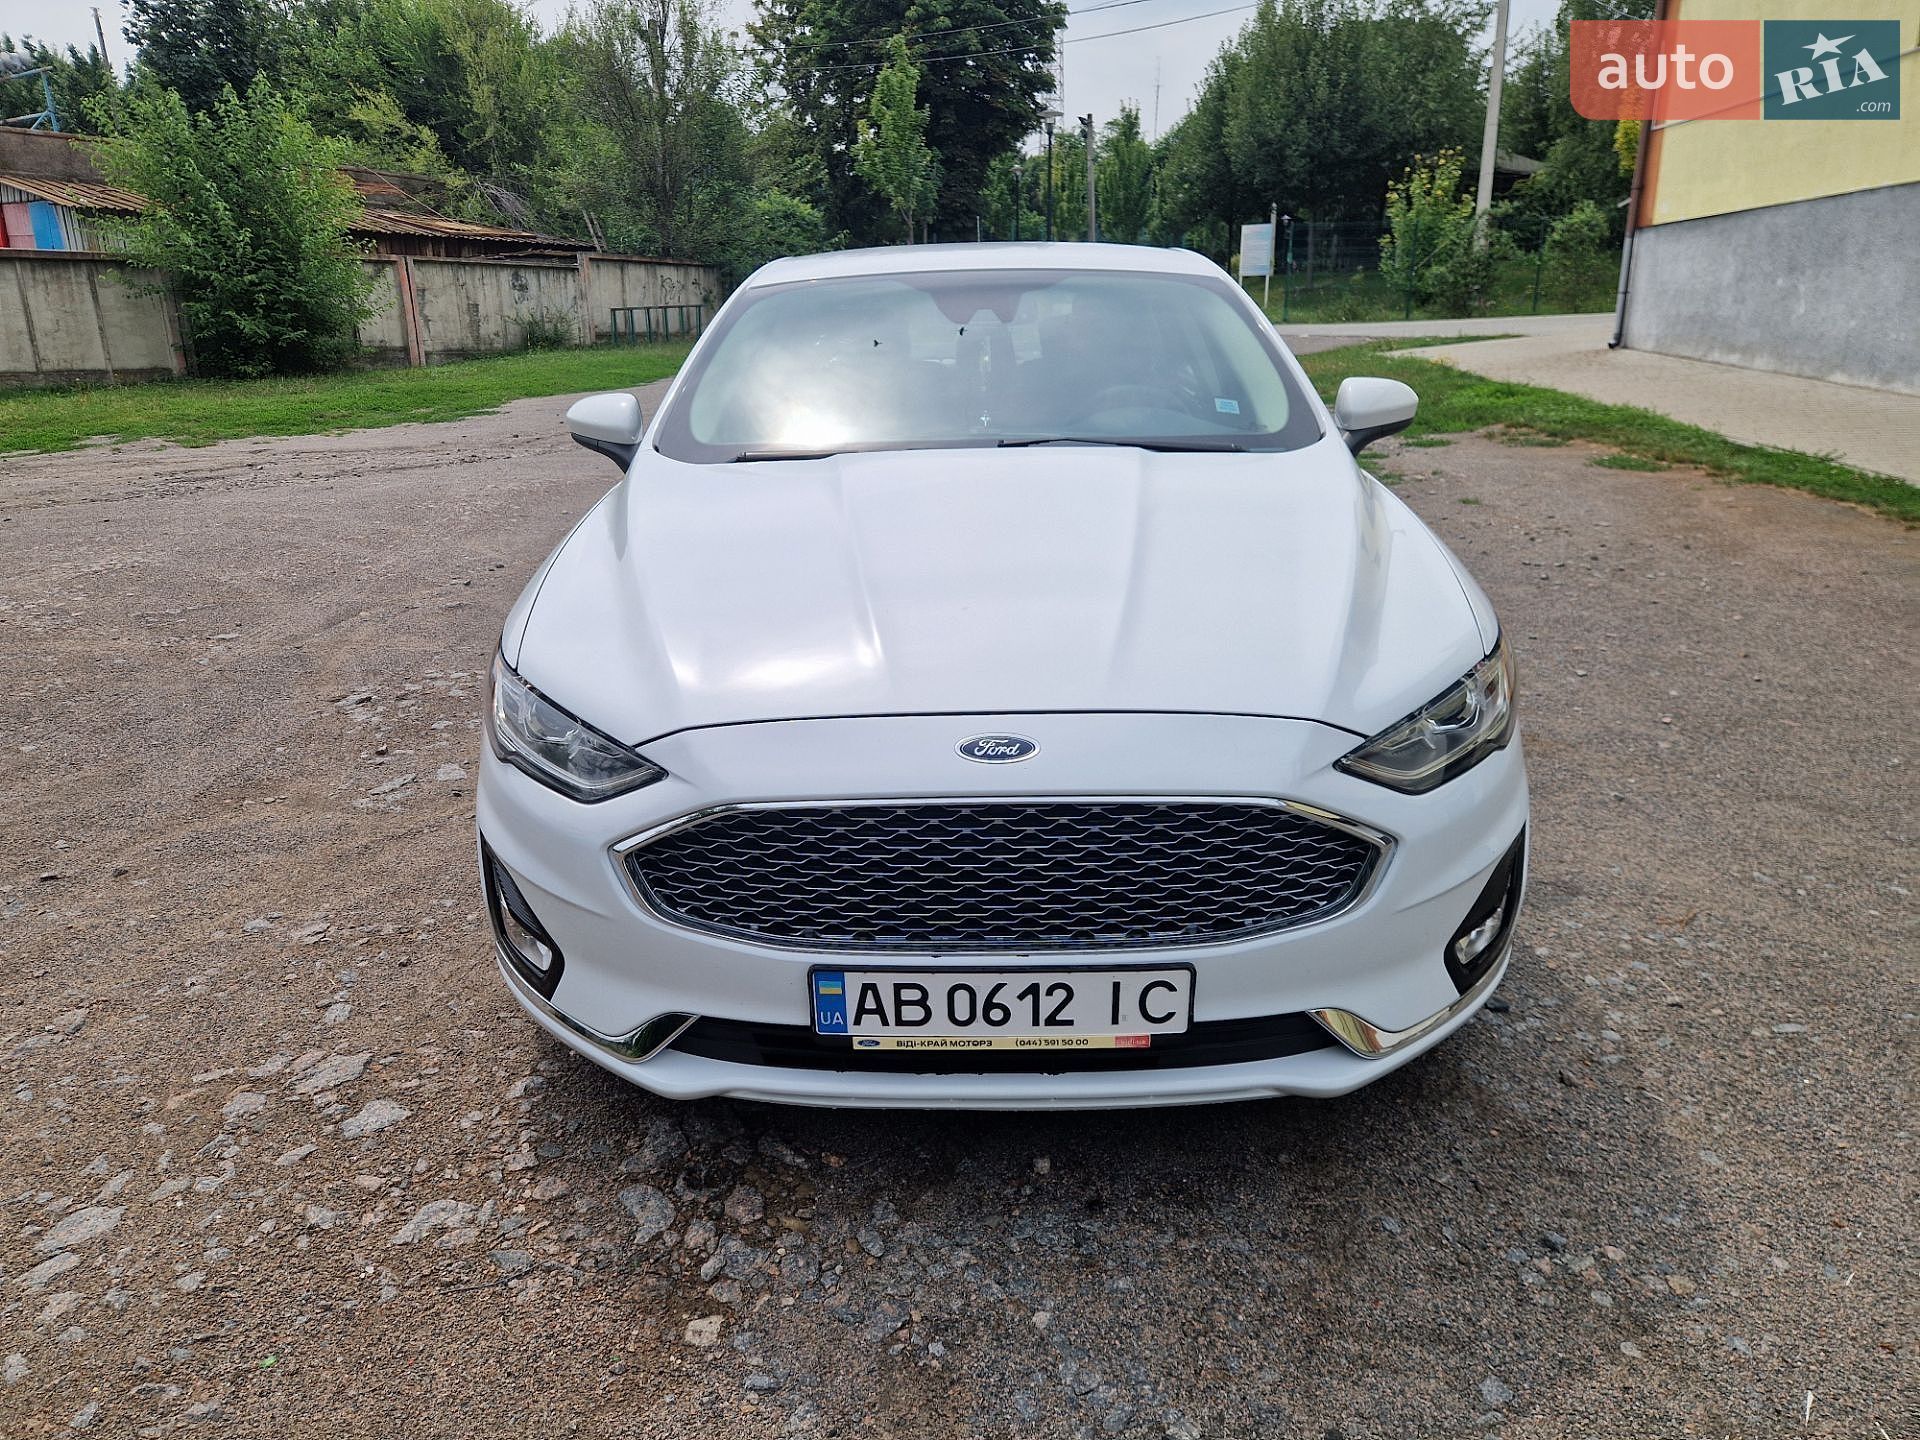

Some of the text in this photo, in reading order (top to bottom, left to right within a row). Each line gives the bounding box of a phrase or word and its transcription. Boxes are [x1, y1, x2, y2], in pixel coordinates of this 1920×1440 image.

[974, 739, 1021, 755] Ford
[853, 980, 1178, 1027] AB 0612 IC
[820, 1011, 844, 1025] UA
[1015, 1038, 1042, 1047] (044)
[1075, 1038, 1089, 1046] 00
